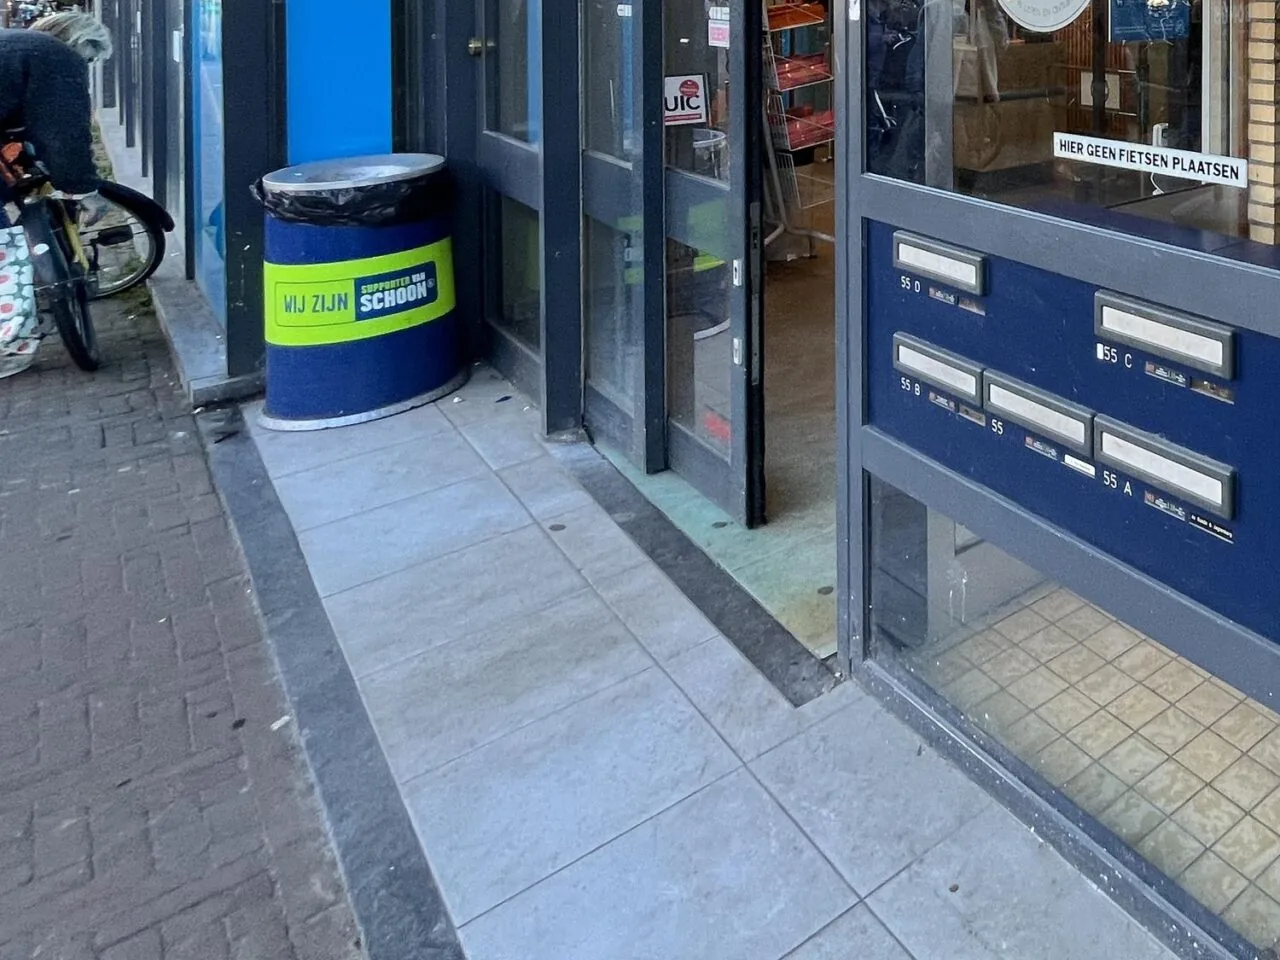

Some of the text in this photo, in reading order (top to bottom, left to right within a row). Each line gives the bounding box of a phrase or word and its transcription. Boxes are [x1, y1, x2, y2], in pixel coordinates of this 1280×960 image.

[1059, 138, 1239, 179] HIER GEEN FIETSEN PLAATSEN
[361, 276, 410, 294] SUPPORTER
[900, 276, 921, 293] 55 D
[284, 293, 349, 314] WIJ ZIJN
[360, 283, 427, 313] SCHOON
[1103, 346, 1133, 368] 55 C
[900, 377, 921, 396] 55 B
[991, 419, 1004, 436] 55
[1103, 471, 1133, 496] 55 A
